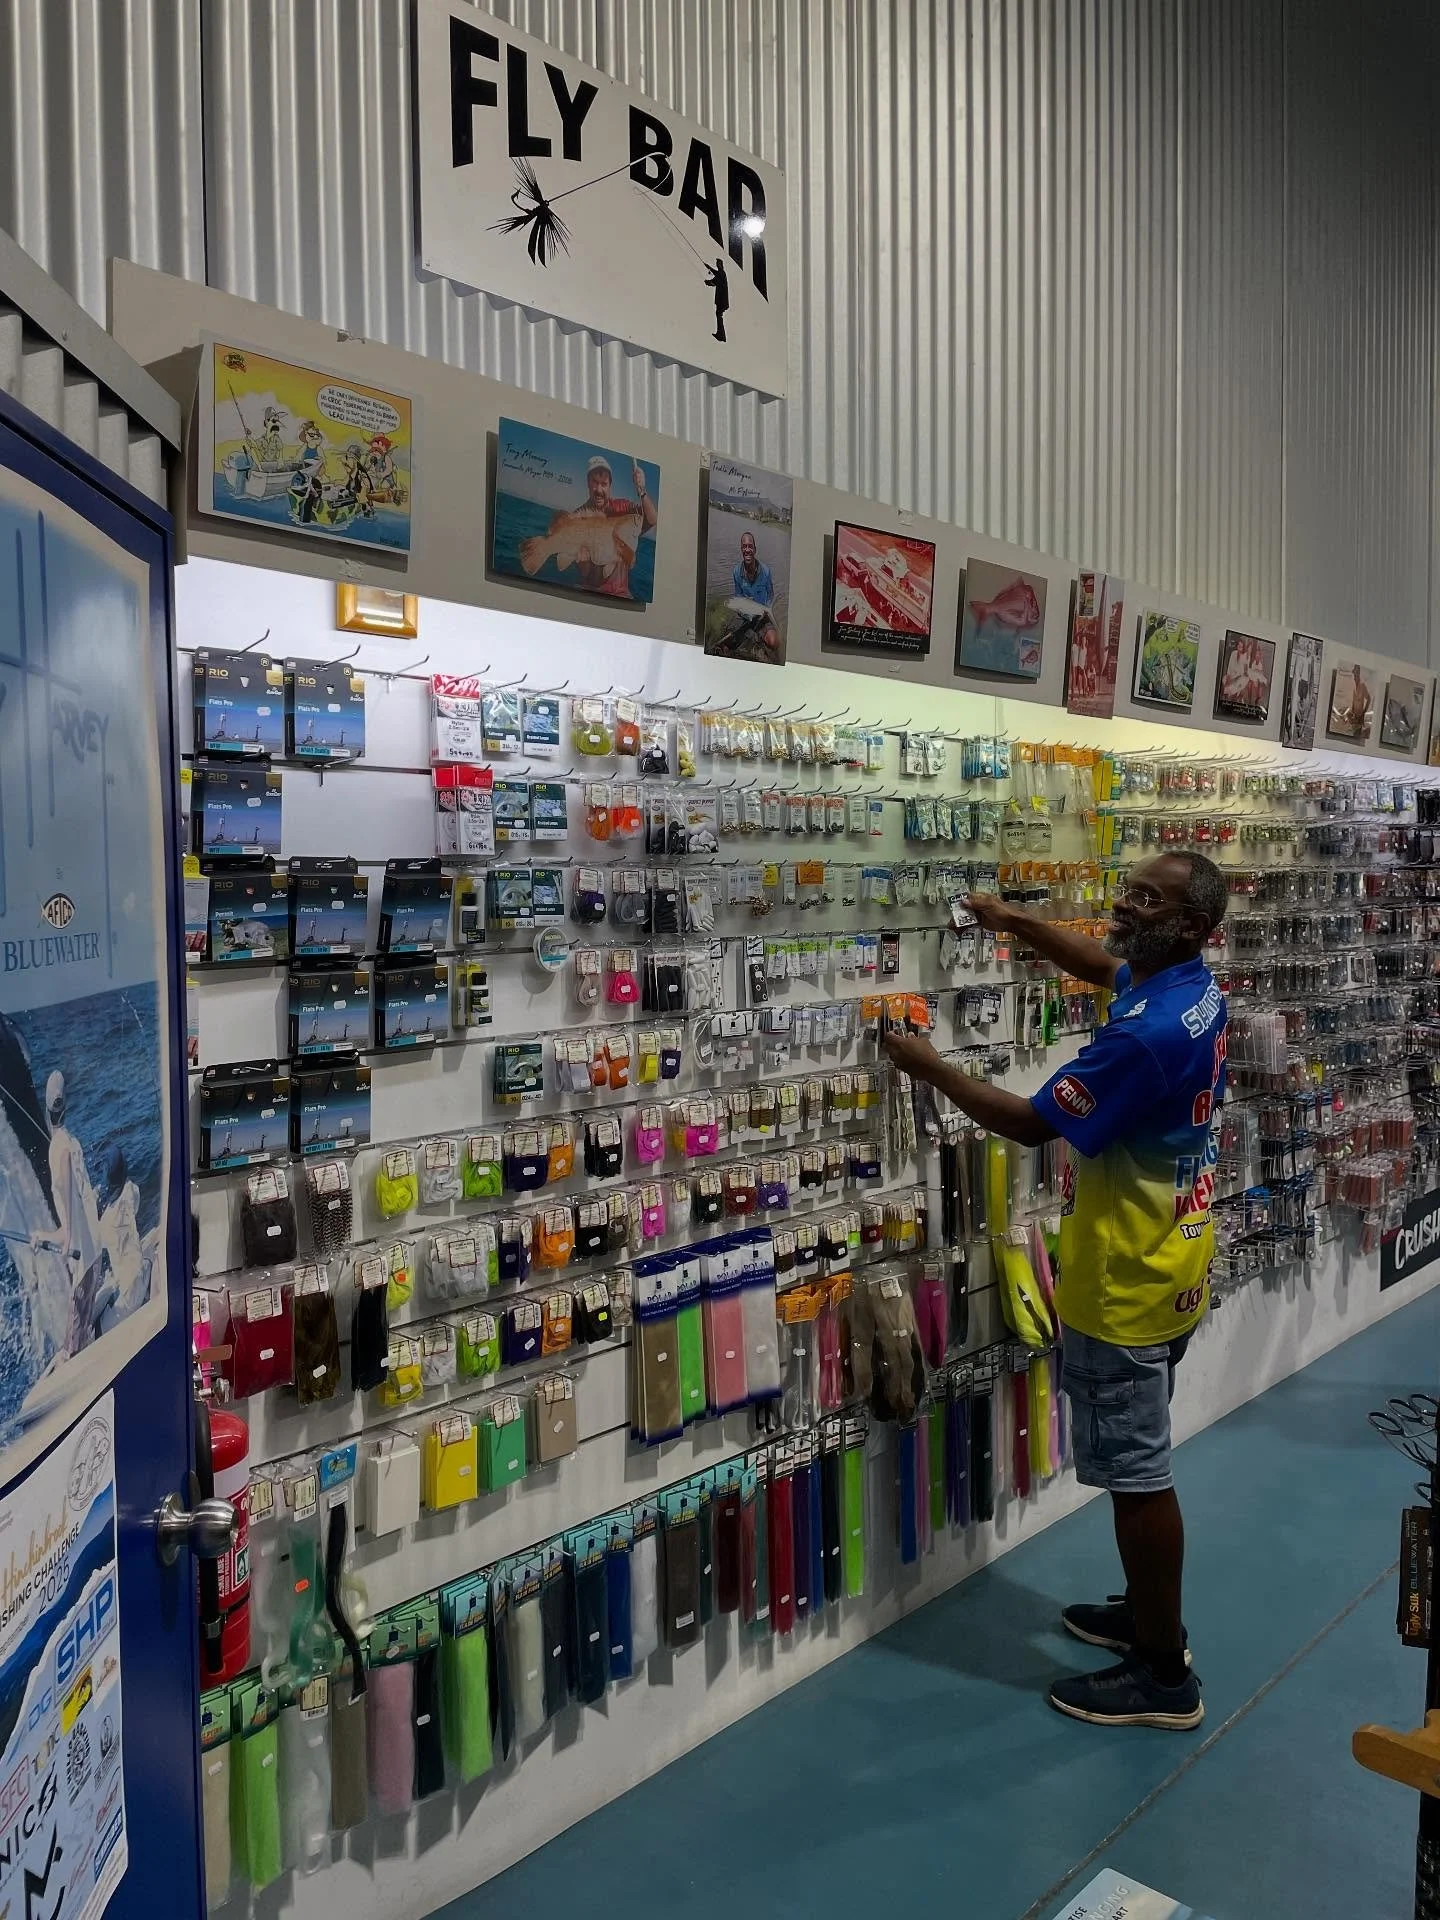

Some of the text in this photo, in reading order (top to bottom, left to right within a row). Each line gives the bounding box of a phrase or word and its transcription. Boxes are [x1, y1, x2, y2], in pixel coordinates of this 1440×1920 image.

[450, 15, 769, 304] FLY BAR
[329, 411, 345, 421] LEAD
[208, 668, 229, 677] RIO
[297, 677, 317, 685] RIO
[208, 698, 223, 706] Flats
[207, 772, 228, 780] RIO
[214, 881, 234, 889] RIO
[3, 932, 100, 972] BLUEWATER
[1056, 1078, 1092, 1114] PENN
[743, 1261, 769, 1272] POLAR
[717, 1269, 738, 1280] POLAR
[647, 1292, 672, 1305] POLAR
[34, 1521, 80, 1590] CHALLENGE
[38, 1556, 71, 1615] 2025
[58, 1578, 114, 1685] SHP
